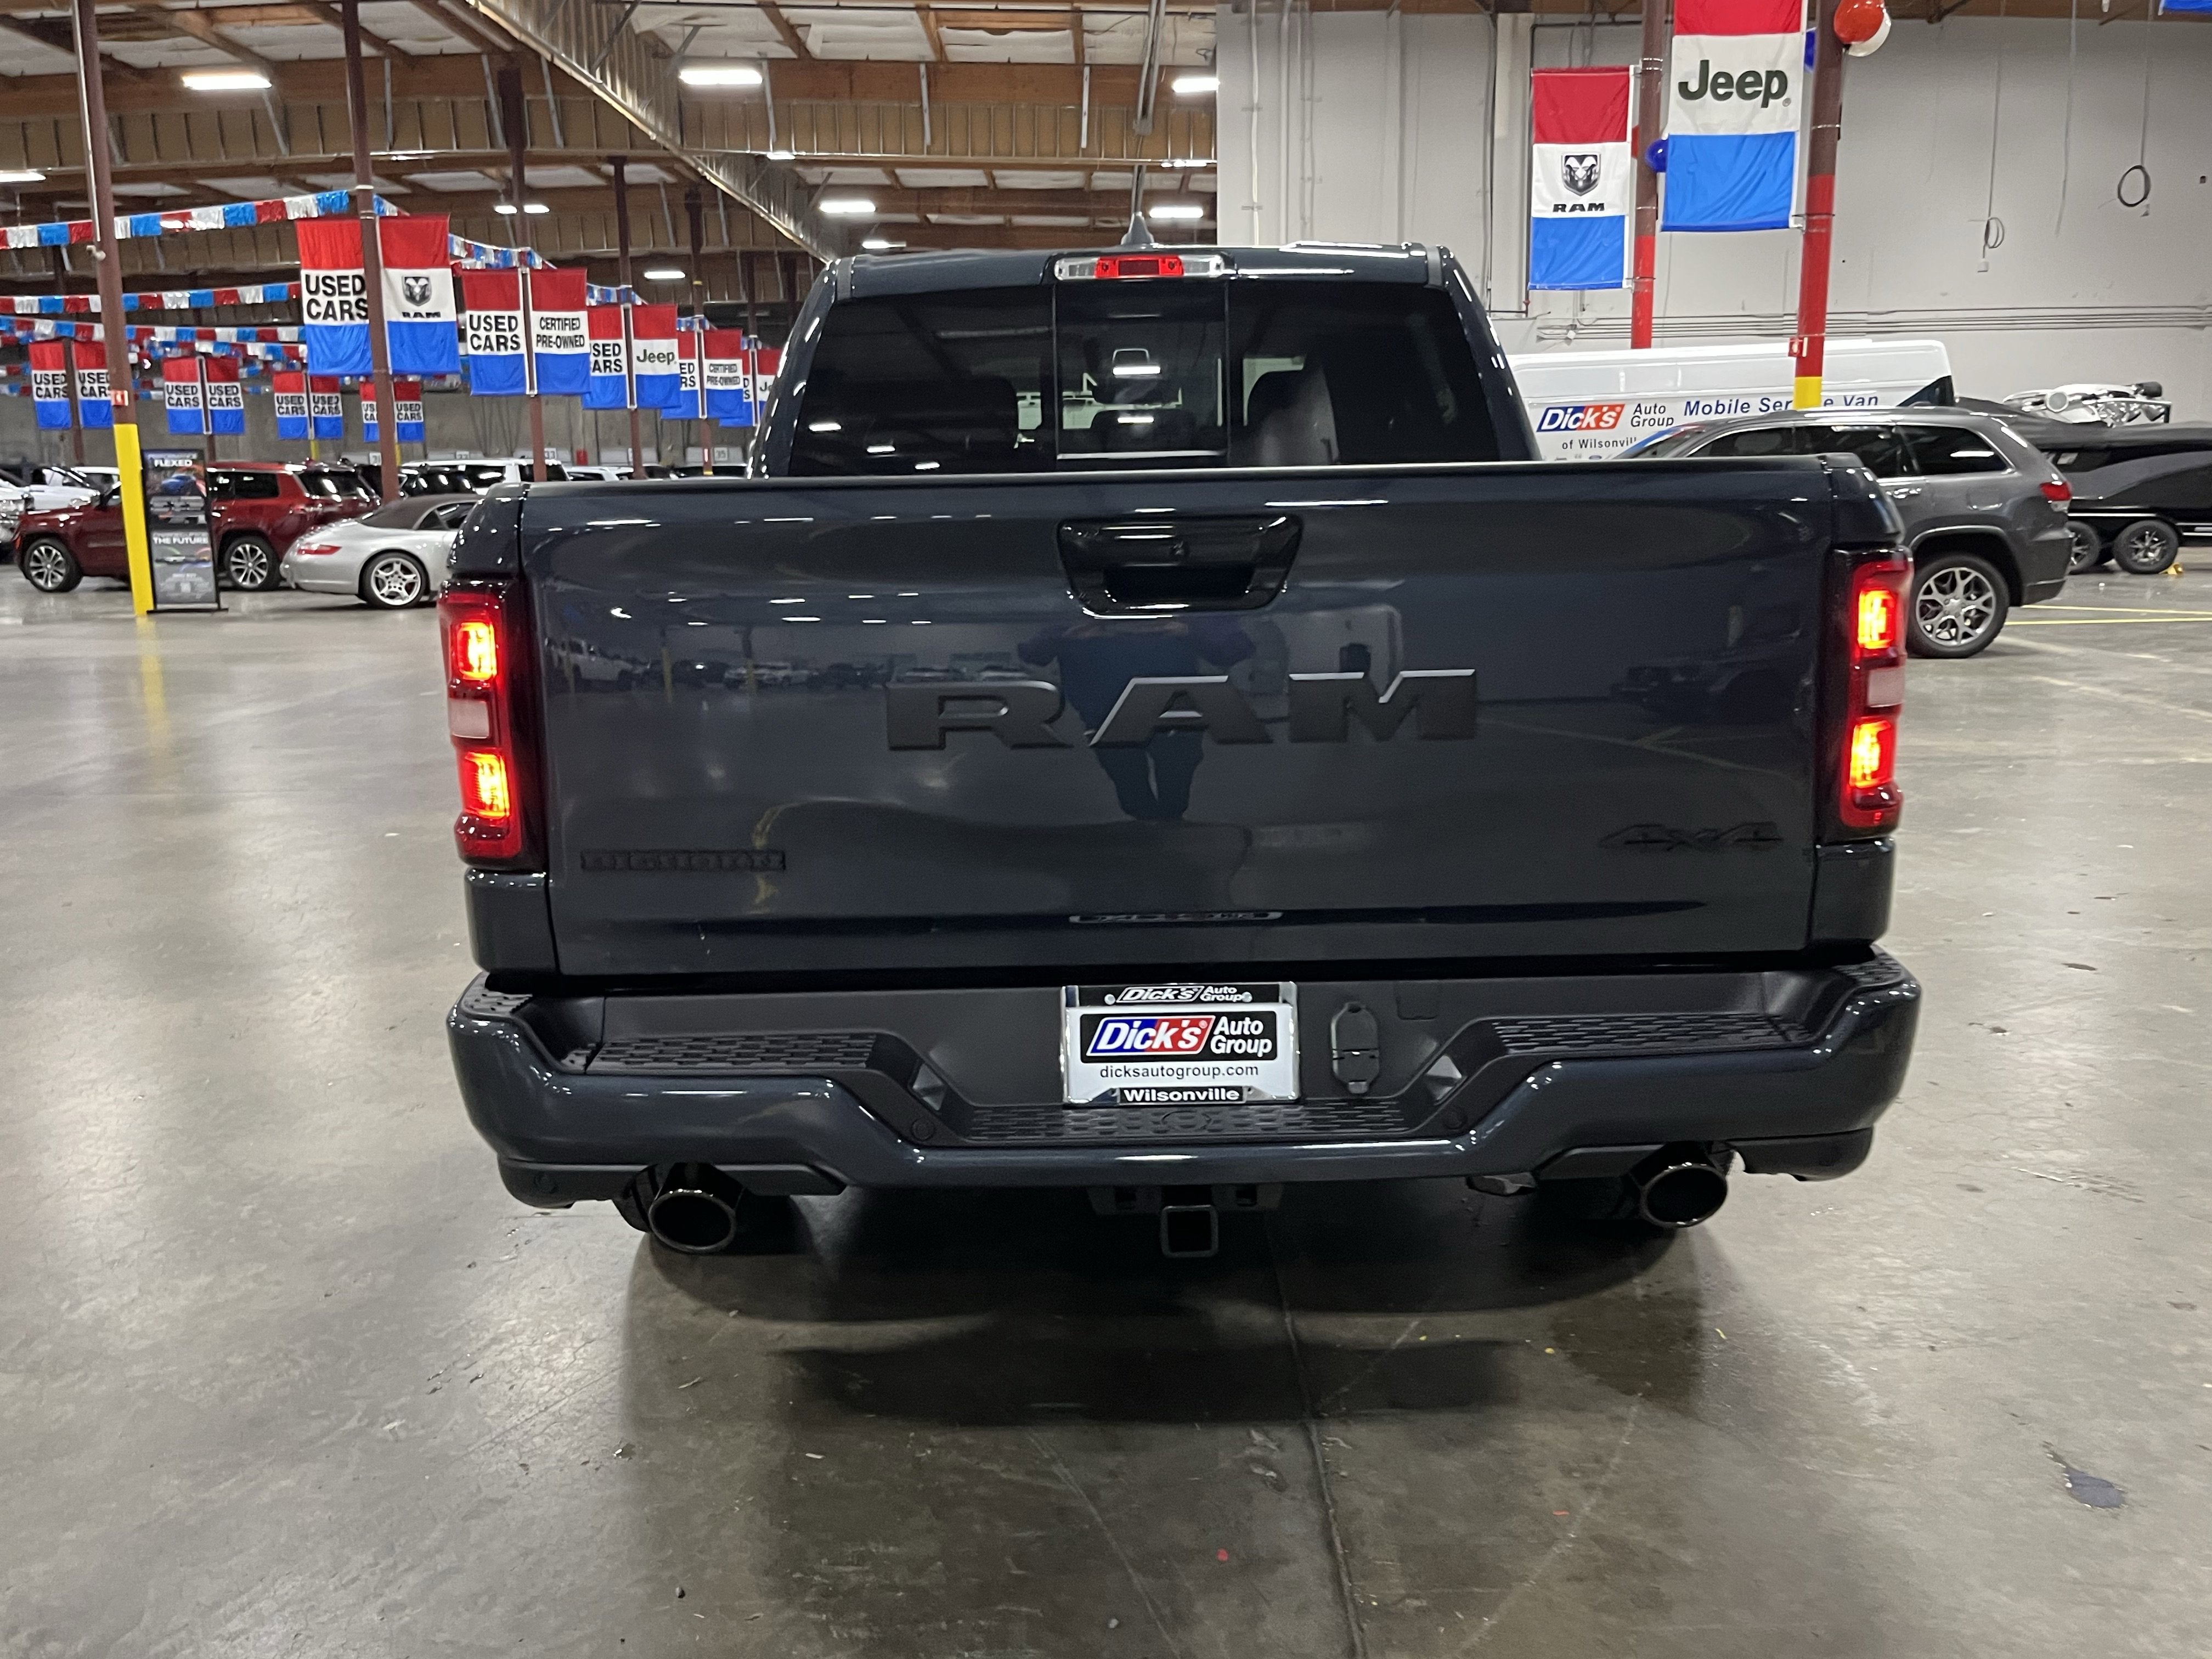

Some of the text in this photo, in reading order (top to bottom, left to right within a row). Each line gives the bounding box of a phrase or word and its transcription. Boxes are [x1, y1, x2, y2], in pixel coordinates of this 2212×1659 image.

[1678, 59, 1788, 108] Jeep
[1553, 202, 1605, 213] RAM
[305, 274, 366, 297] USED
[306, 298, 368, 321] CARS
[469, 314, 518, 332] USED
[539, 317, 580, 331] CERTIFIED
[470, 334, 521, 352] CARS
[536, 334, 585, 349] PRE-OWNED
[590, 343, 622, 357] SED
[636, 349, 675, 365] Jeep
[591, 358, 623, 373] ARS
[679, 363, 695, 374] ED
[680, 376, 696, 387] RS
[81, 386, 111, 397] CAR
[166, 385, 198, 396] USED
[208, 385, 239, 396] USED
[167, 397, 199, 407] CARS
[209, 397, 241, 407] CARS
[276, 396, 304, 405] USED
[313, 395, 340, 404] USED
[1684, 395, 1878, 416] Mobile Sere Van
[277, 405, 306, 415] CARS
[313, 405, 340, 415] CARS
[363, 403, 375, 411] US
[396, 403, 421, 411] USED
[1633, 403, 1666, 415] Auto
[397, 412, 422, 421] CARS
[1541, 407, 1618, 430] Dick's
[1630, 415, 1674, 427] Group
[1562, 437, 1637, 449] of Wilsonvil
[887, 669, 1477, 751] RAM
[1125, 987, 1195, 1001] Dick's
[1199, 993, 1243, 1002] Group
[1213, 1016, 1264, 1036] Auto
[1096, 1019, 1201, 1051] Dick's
[1210, 1035, 1272, 1057] Group
[1100, 1065, 1259, 1080] dicksautogroup.com
[1123, 1087, 1240, 1102] Wilsonville
